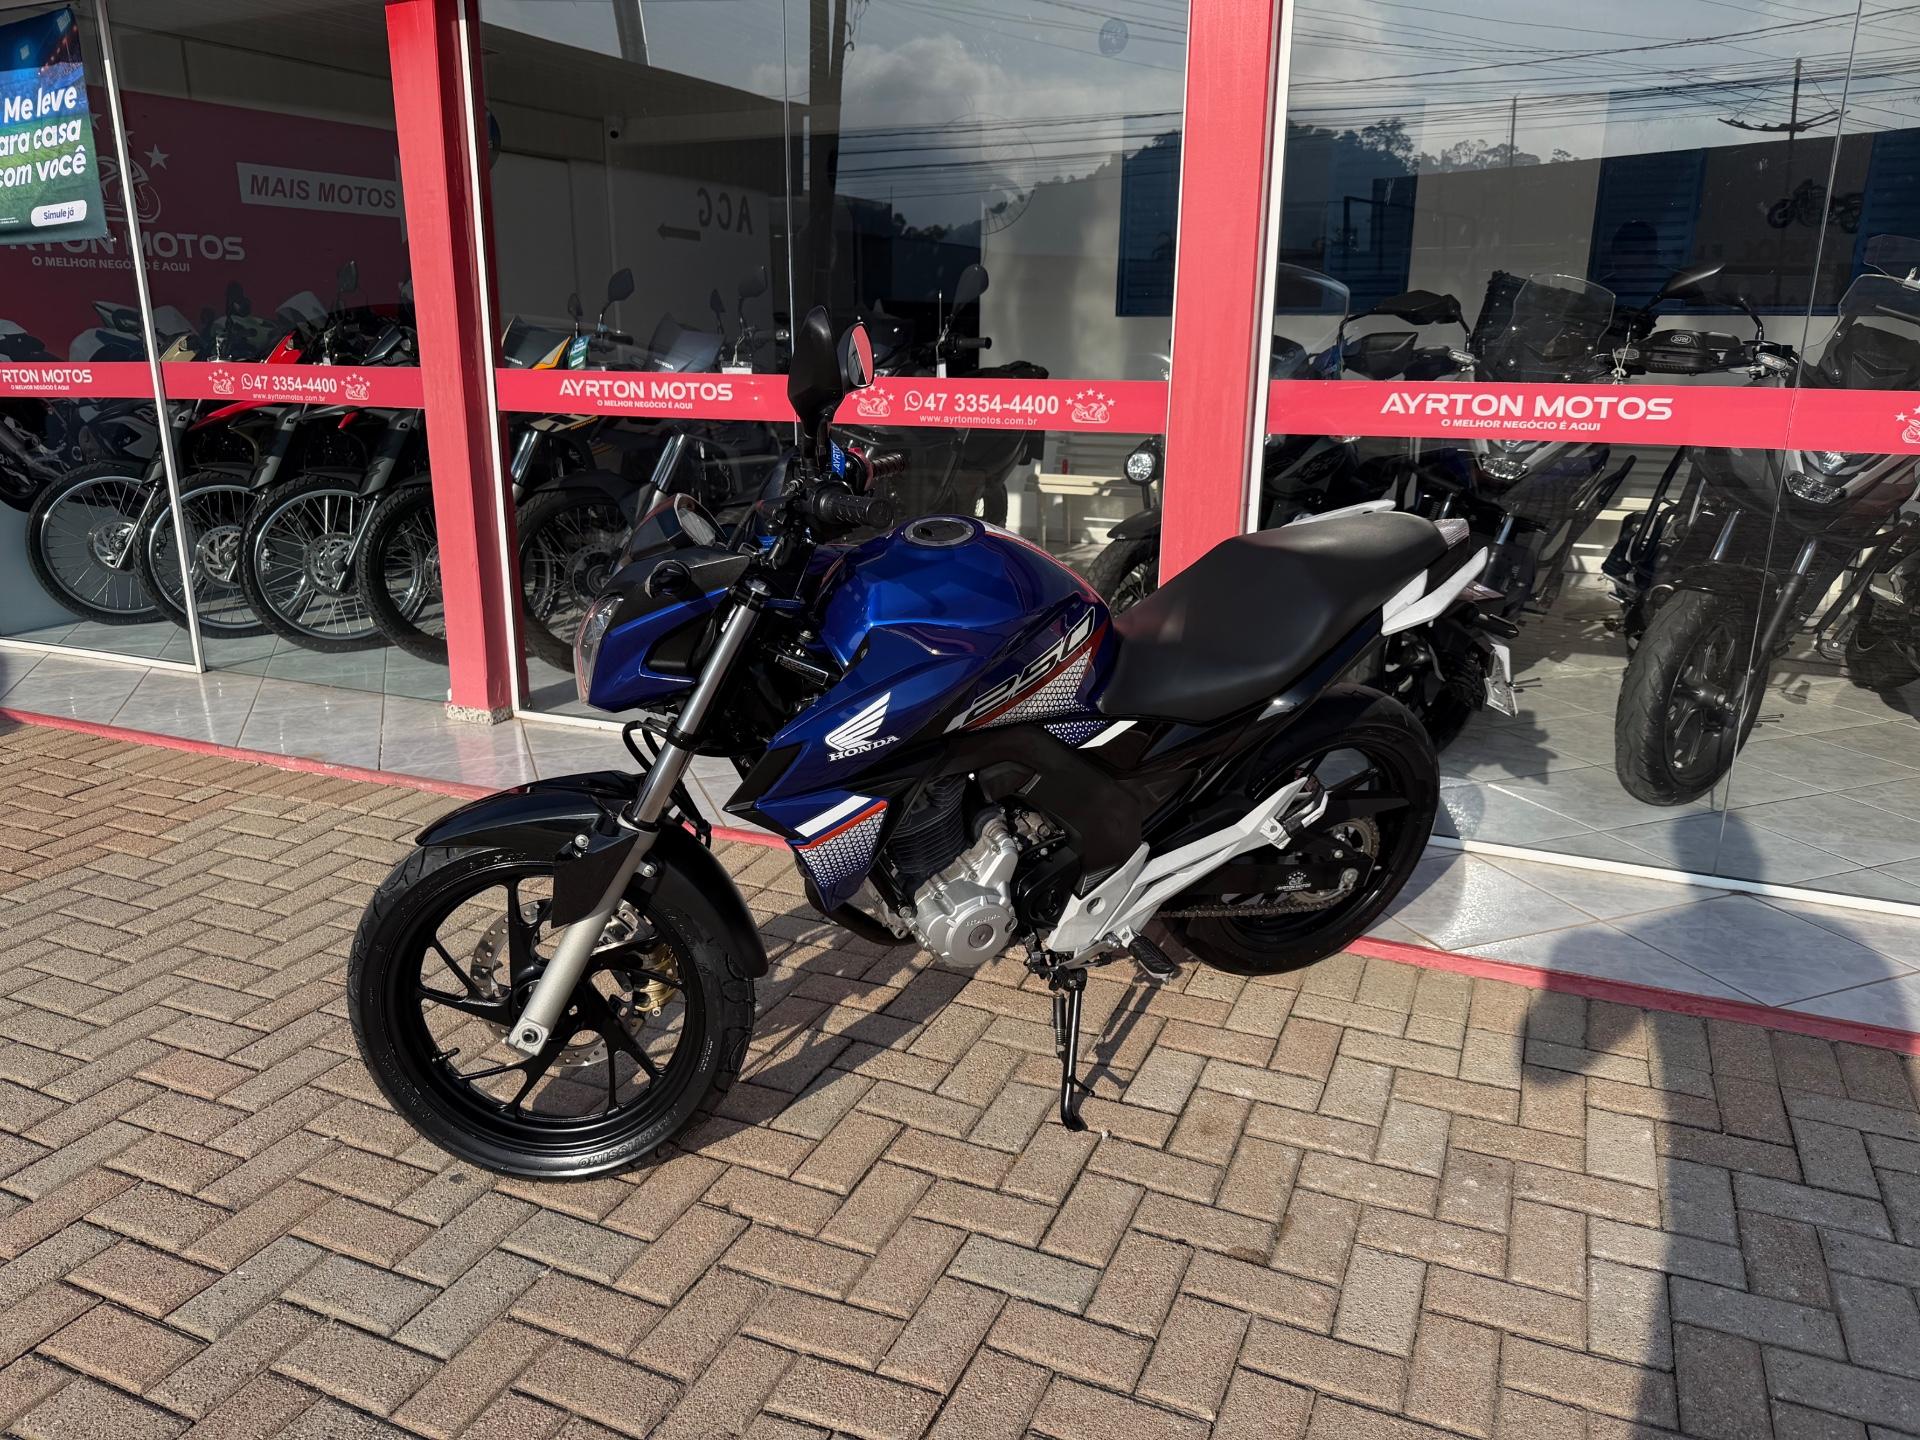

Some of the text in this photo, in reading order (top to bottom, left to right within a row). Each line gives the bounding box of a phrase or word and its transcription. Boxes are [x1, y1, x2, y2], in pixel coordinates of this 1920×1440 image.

[4, 86, 78, 123] Me leve
[34, 119, 81, 149] casa
[36, 144, 86, 181] você
[250, 174, 396, 209] MAIS MOTOS
[43, 206, 75, 220] Simule já
[32, 256, 41, 266] O
[44, 257, 96, 269] MELHOR
[153, 260, 159, 271] É
[162, 262, 191, 272] AQUI
[0, 369, 93, 383] RTON MOTOS
[254, 375, 337, 393] 47 3354-4400
[559, 379, 733, 401] AYRTON MOTOS
[604, 400, 634, 408] MELHOR
[634, 401, 667, 409] NEGÓCIO
[668, 400, 672, 409] É
[674, 402, 693, 410] AQUI
[924, 393, 1059, 414] 47 3354-4400
[1380, 392, 1674, 420] AYRTON MOTOS
[919, 414, 1038, 426] www.ayrtonmotos.com.br
[1441, 418, 1601, 431] O MELHOR NEGÓCIO É AQUI
[958, 606, 1096, 732] 250
[828, 735, 900, 761] HONDA
